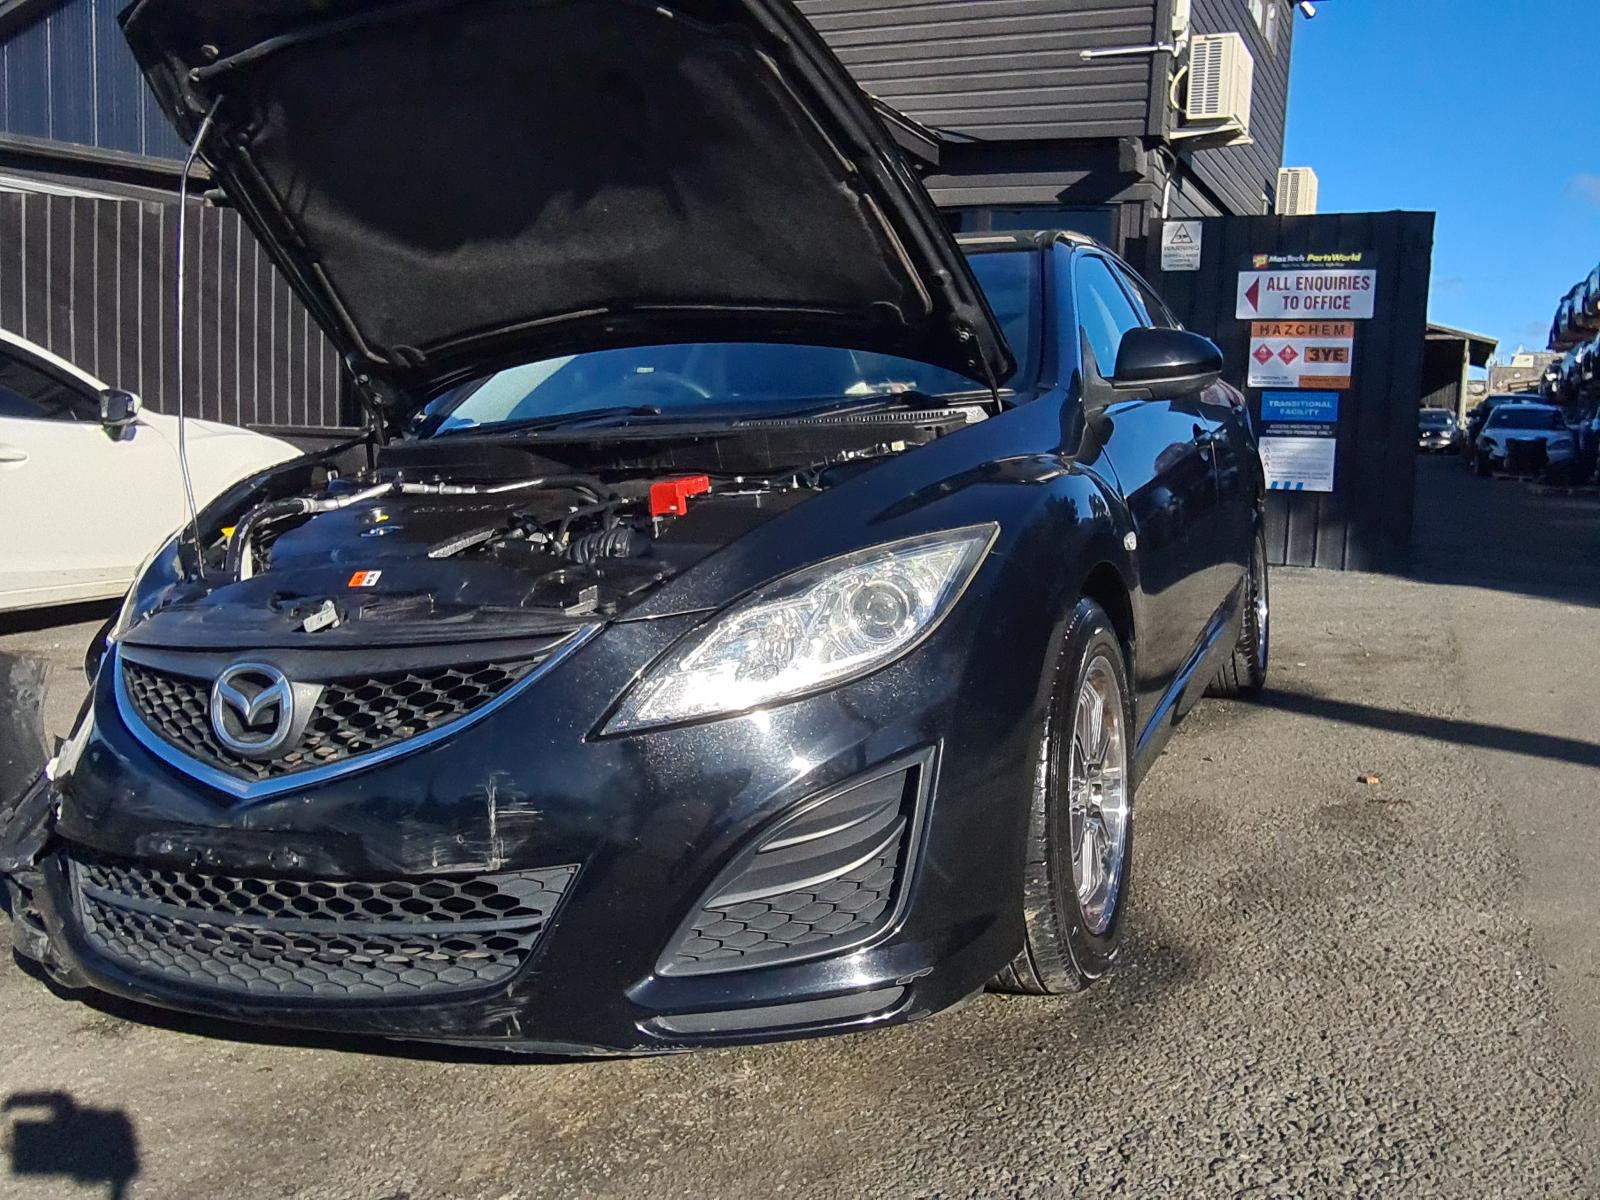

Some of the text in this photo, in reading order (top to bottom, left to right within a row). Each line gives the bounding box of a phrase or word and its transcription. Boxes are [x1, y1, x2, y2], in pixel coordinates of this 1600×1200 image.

[1267, 275, 1370, 292] ALL ENQUIRIES
[1283, 295, 1351, 310] TO OFFICE
[1260, 324, 1345, 336] HAZCHEM
[1309, 349, 1344, 361] 3YE
[1280, 408, 1319, 416] FACILITY
